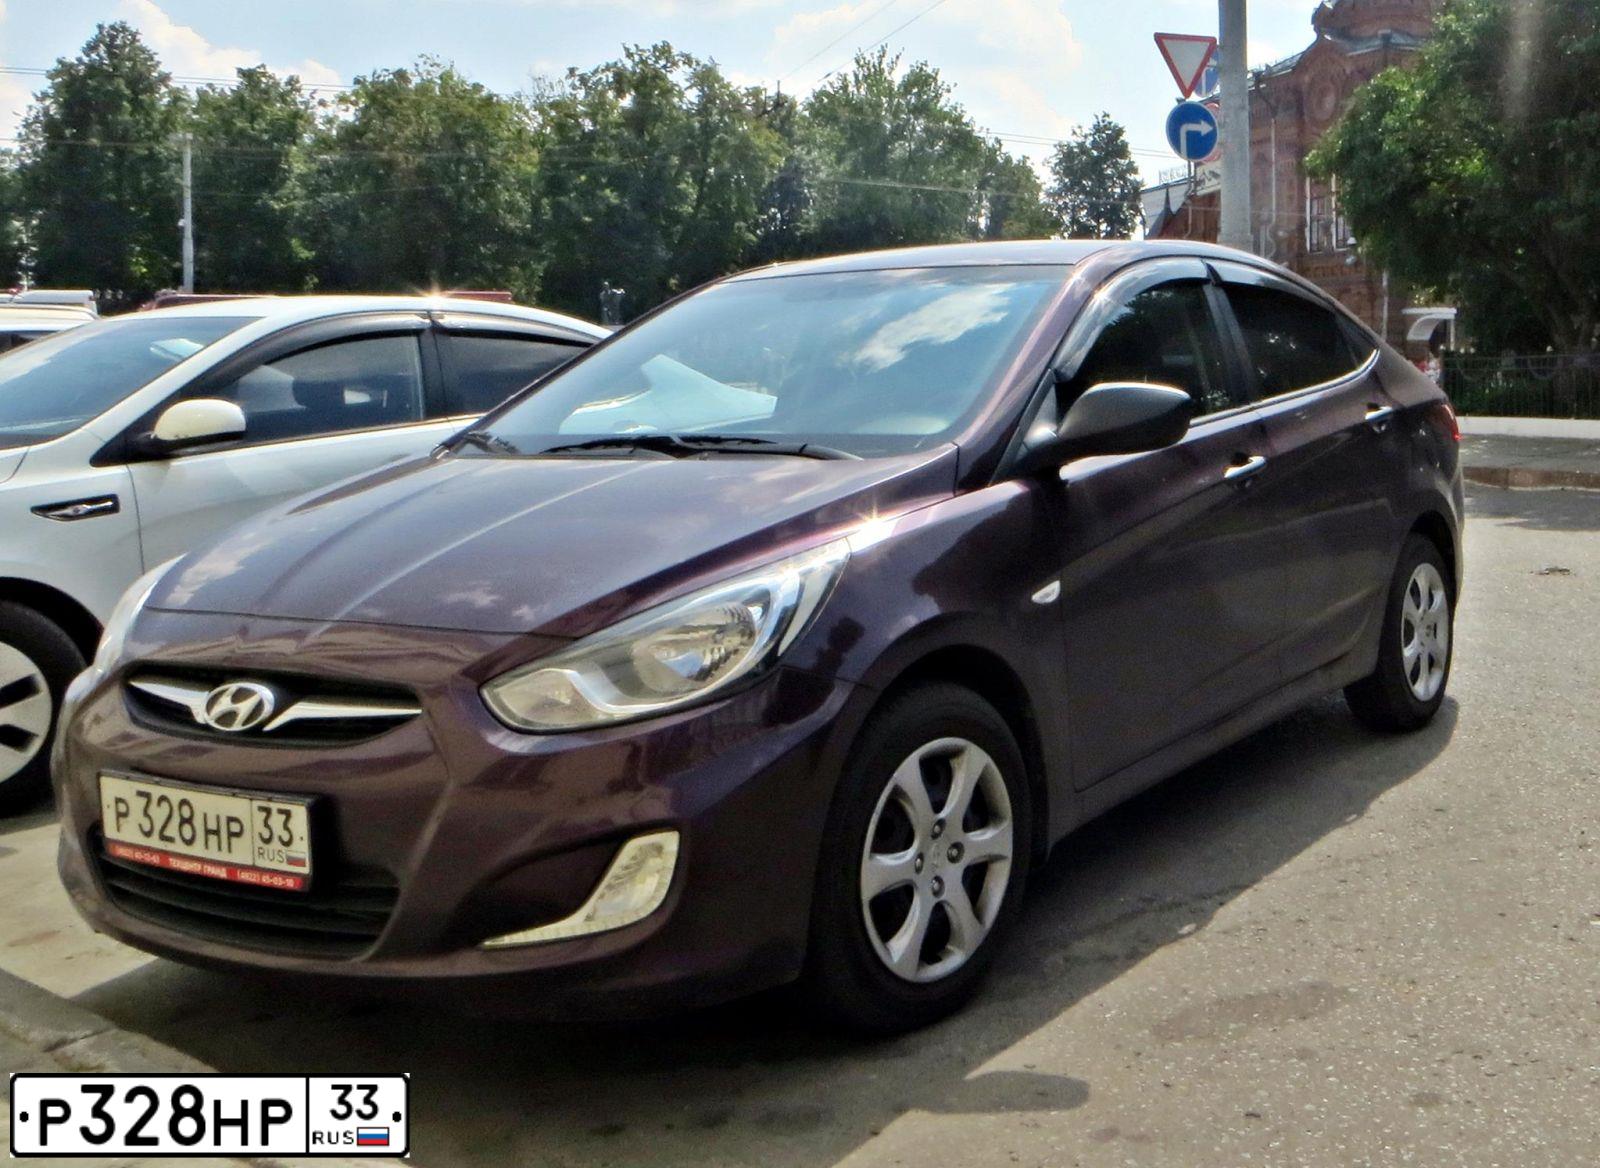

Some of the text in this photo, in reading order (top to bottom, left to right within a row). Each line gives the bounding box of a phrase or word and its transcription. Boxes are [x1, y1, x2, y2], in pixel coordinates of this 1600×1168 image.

[115, 790, 245, 854] Р328НР
[258, 806, 294, 847] 33
[258, 848, 285, 863] RUS
